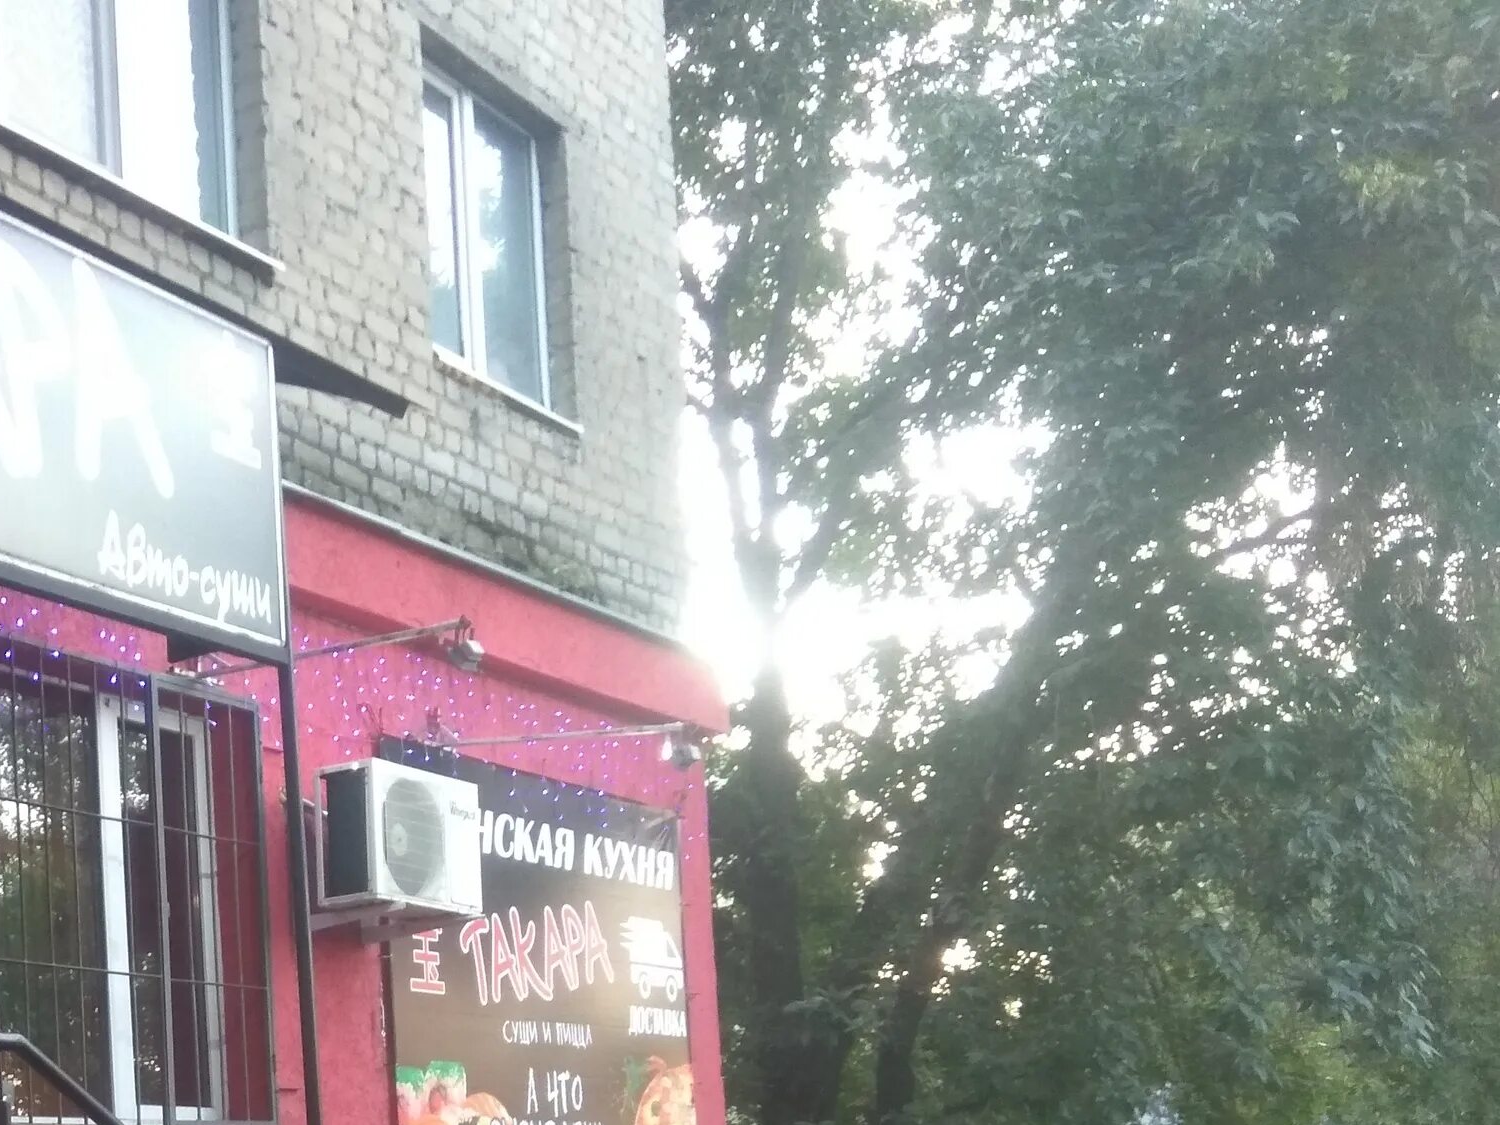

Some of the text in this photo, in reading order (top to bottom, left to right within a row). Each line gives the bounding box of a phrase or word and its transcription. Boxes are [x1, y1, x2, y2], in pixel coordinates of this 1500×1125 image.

[477, 807, 675, 891] НСКАЯ КУХНЯ
[459, 899, 615, 1007] ТАКАРА
[541, 1020, 553, 1045] И
[555, 1021, 593, 1050] ПИЦЦА
[627, 1004, 688, 1038] ДОСТАВКА
[526, 1066, 584, 1118] А ЧТО
